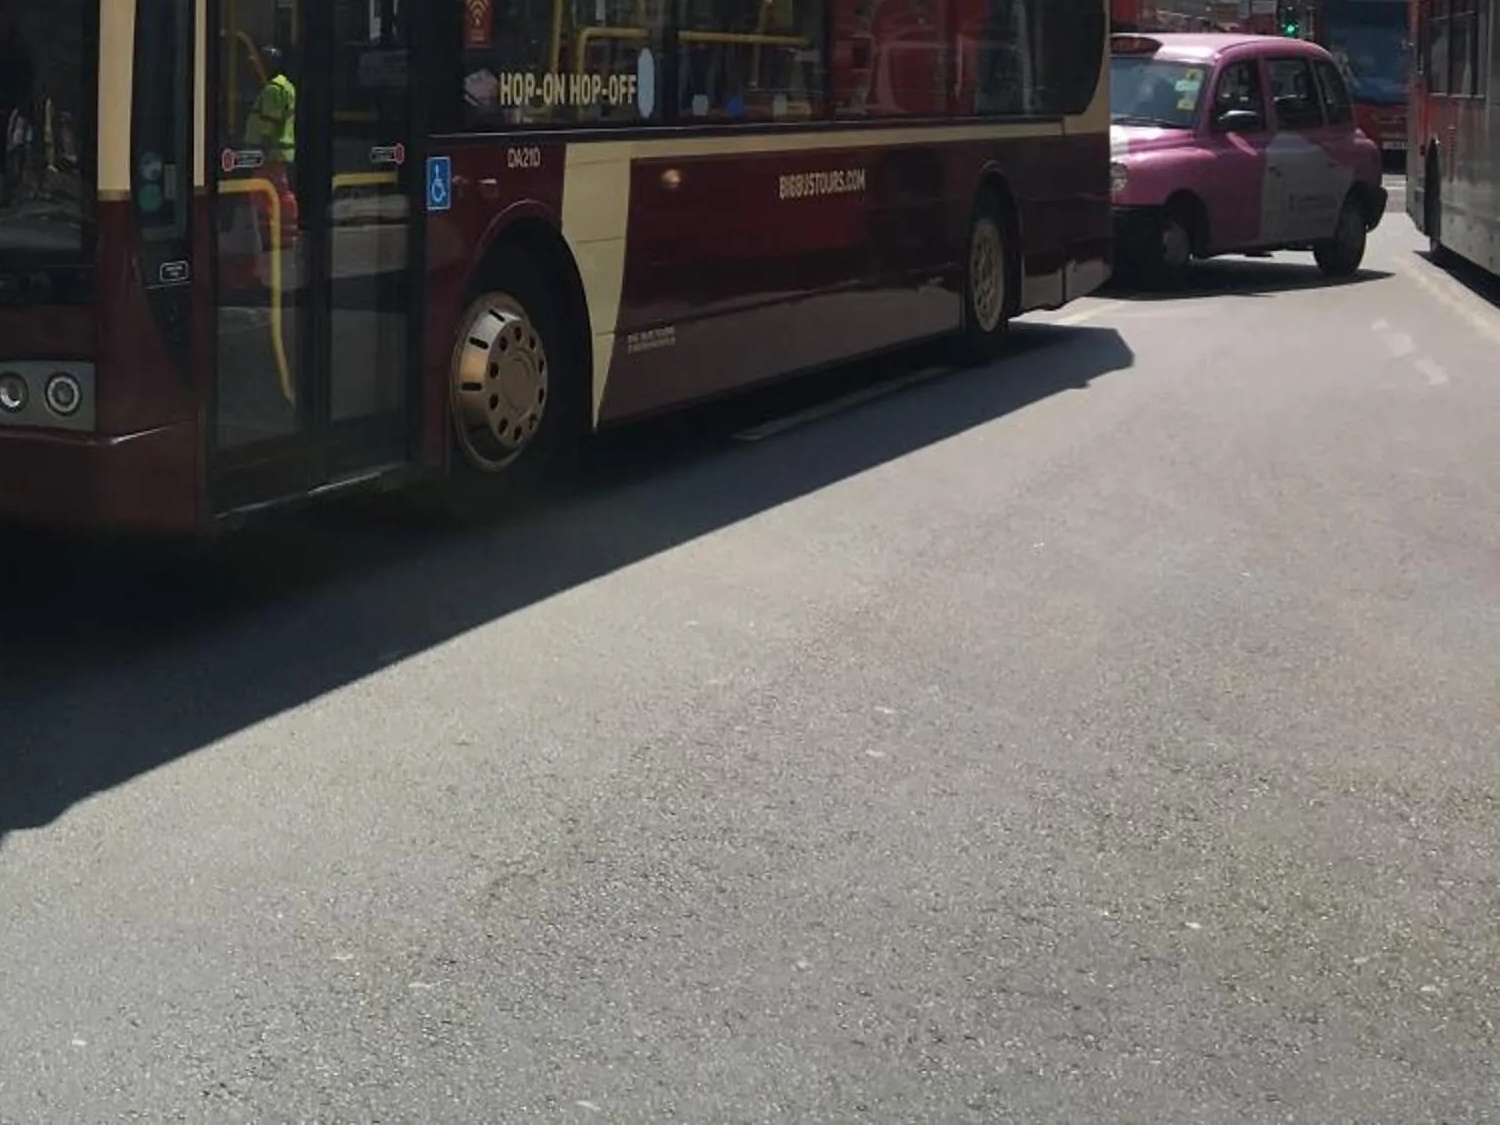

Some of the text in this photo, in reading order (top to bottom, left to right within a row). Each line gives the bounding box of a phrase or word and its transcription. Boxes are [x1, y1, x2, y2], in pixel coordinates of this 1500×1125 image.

[501, 72, 636, 106] HOP-ON HOP-OFF
[507, 147, 541, 168] DA210
[779, 167, 866, 199] BIGBUSTOURS.COM
